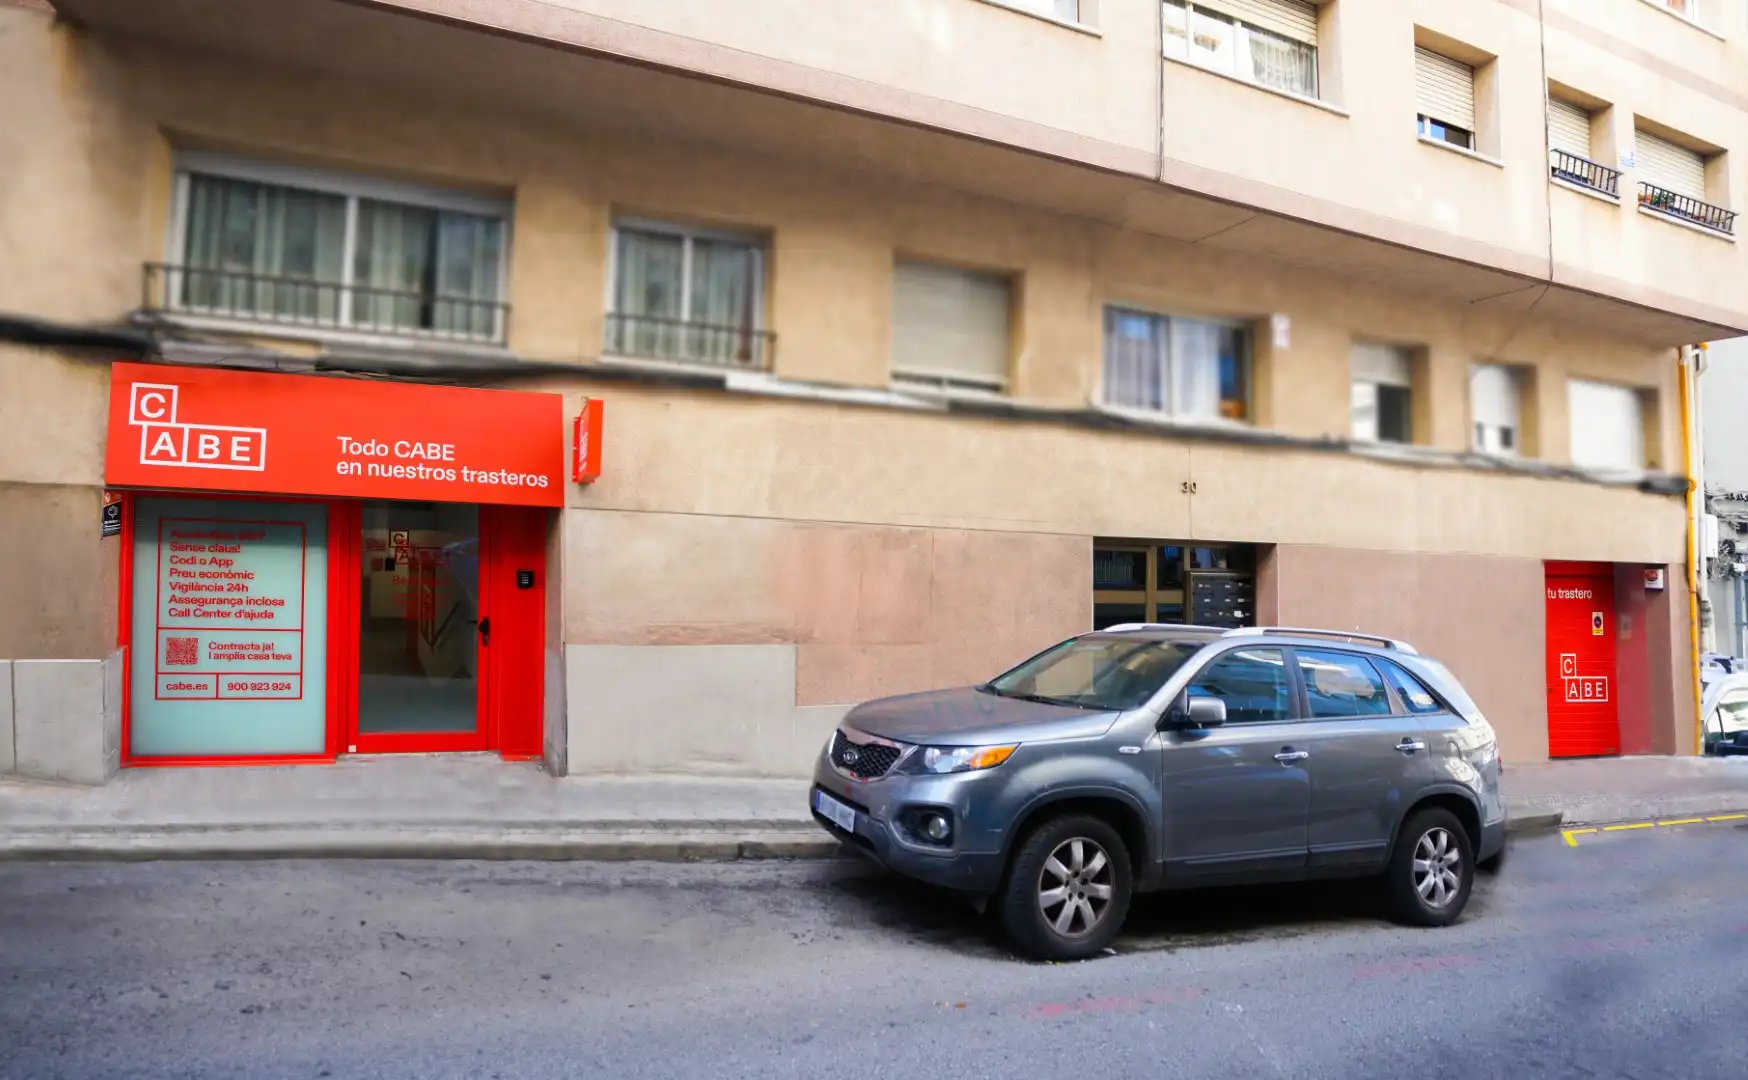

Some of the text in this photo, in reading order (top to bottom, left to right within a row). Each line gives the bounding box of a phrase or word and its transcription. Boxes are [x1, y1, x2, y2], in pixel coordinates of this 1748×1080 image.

[336, 436, 455, 461] Todo CABE
[336, 460, 549, 488] en nuestros trasteros
[1181, 481, 1197, 493] 30
[169, 541, 241, 553] Sense claus!
[169, 555, 197, 565] Codi
[209, 556, 233, 568] App
[169, 568, 196, 578] Preu
[227, 583, 249, 592] 24h
[1547, 588, 1592, 599] tu trastero
[168, 594, 285, 607] Assegurança inclosa
[168, 608, 274, 621] Call Center d'ajuda
[208, 642, 274, 652] Contracta ja!
[213, 652, 246, 662] amplia
[166, 681, 208, 691] cabe.es
[227, 682, 292, 691] 900 923 924
